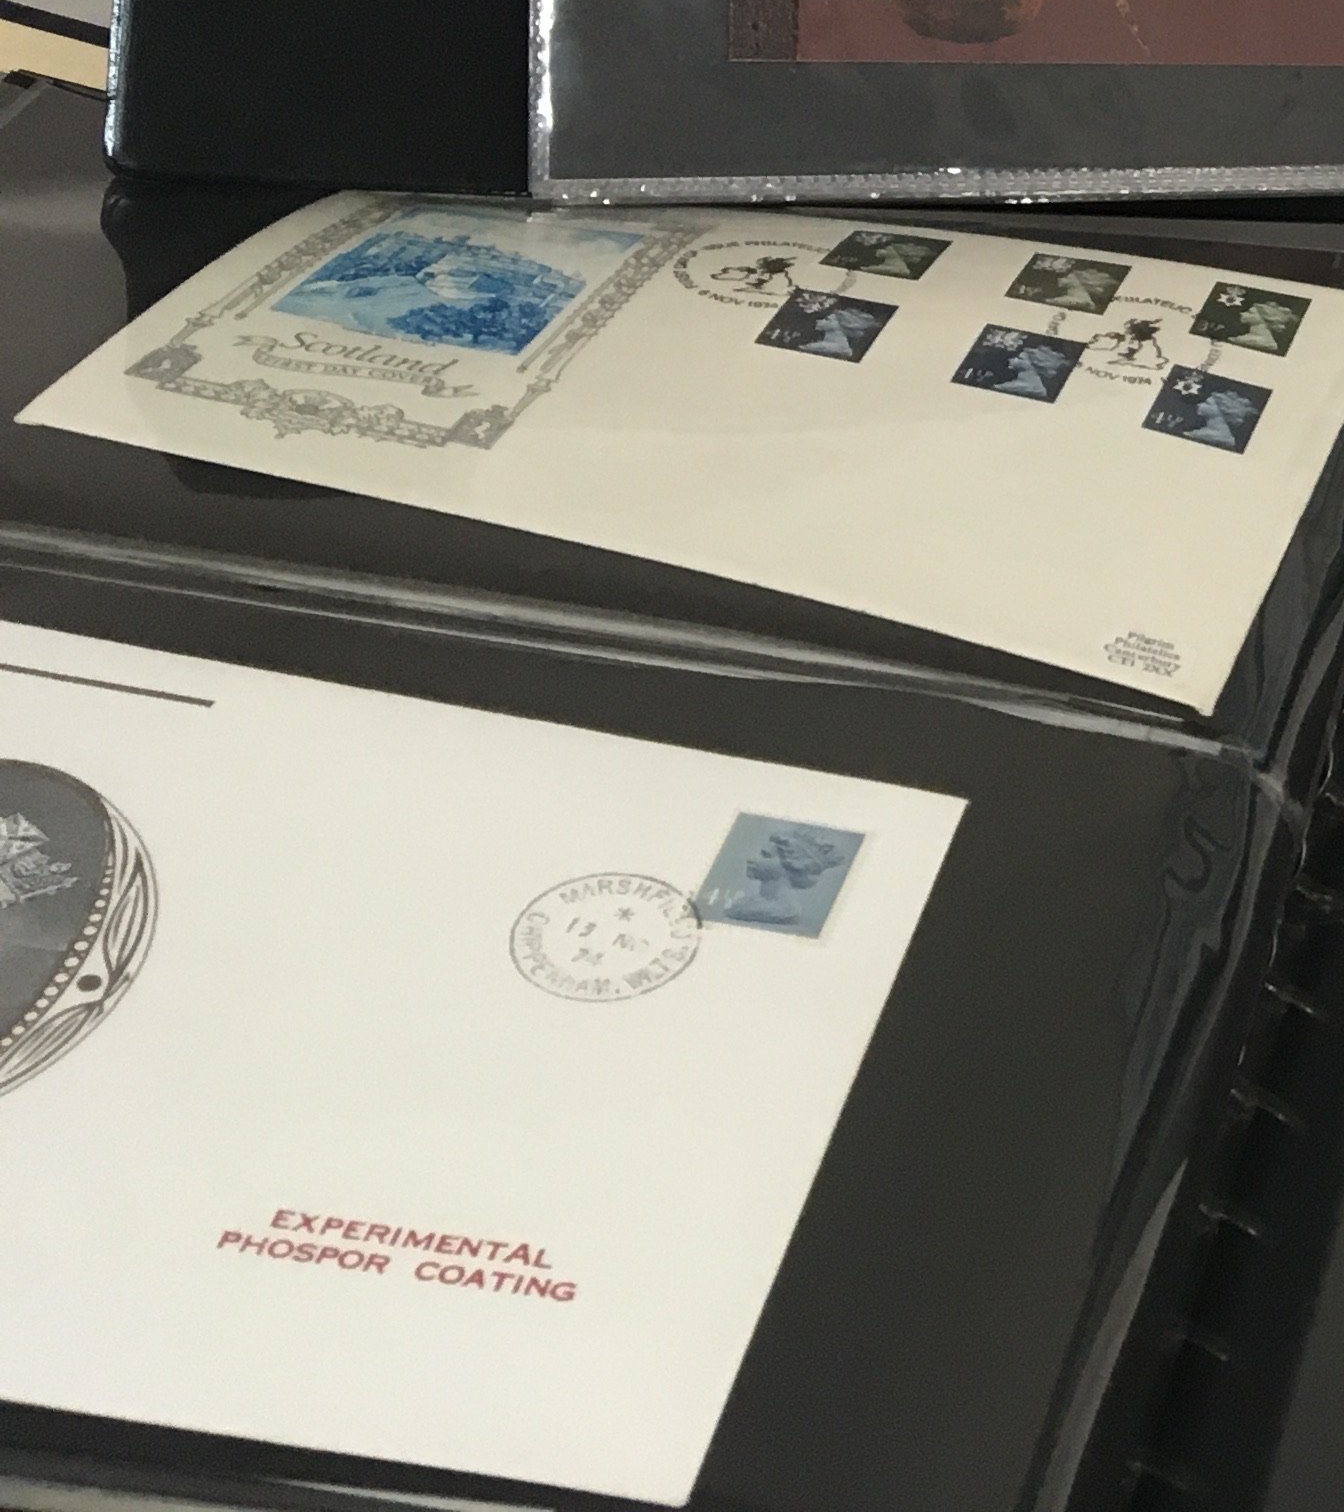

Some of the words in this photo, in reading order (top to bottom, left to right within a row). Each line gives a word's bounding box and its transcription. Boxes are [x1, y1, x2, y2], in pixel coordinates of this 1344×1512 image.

[278, 332, 459, 374] Scotland
[216, 1230, 391, 1274] PHOSPOR
[414, 1261, 579, 1302] COATING
[270, 1208, 553, 1269] EXPERIMENTAL
